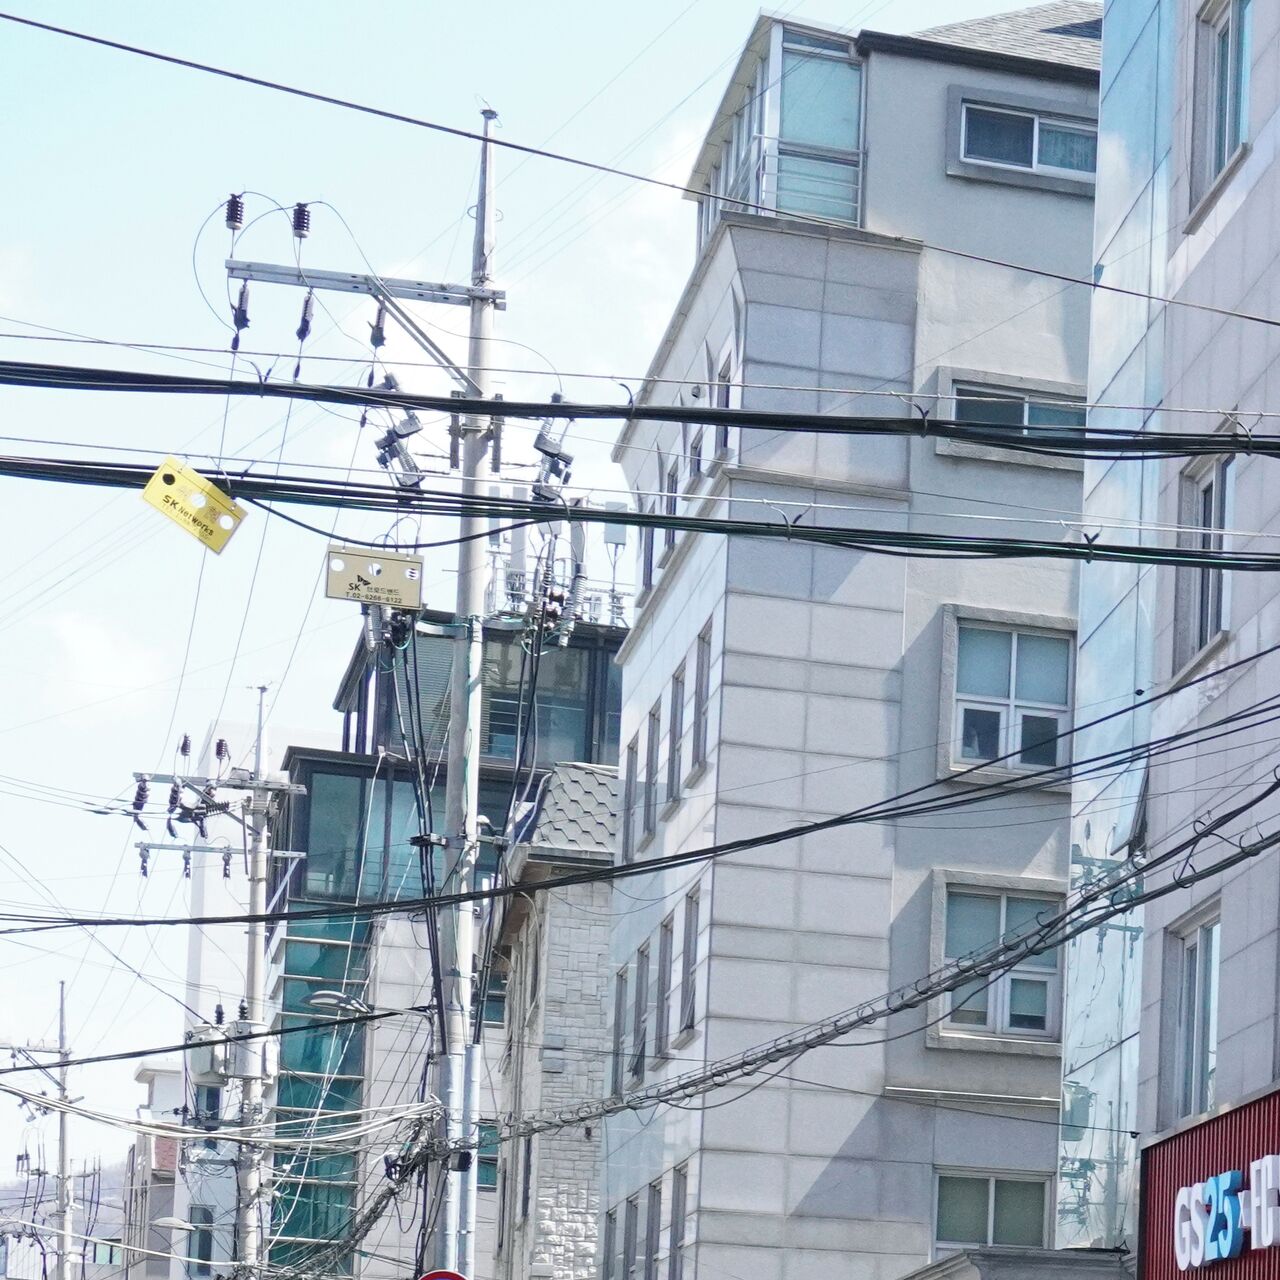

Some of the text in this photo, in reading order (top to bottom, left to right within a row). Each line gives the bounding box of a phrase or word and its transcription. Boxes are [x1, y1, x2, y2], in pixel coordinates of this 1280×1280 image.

[162, 494, 180, 509] SK
[348, 582, 361, 591] SK
[1174, 1169, 1243, 1271] GS25
[1250, 1154, 1279, 1250] FC
